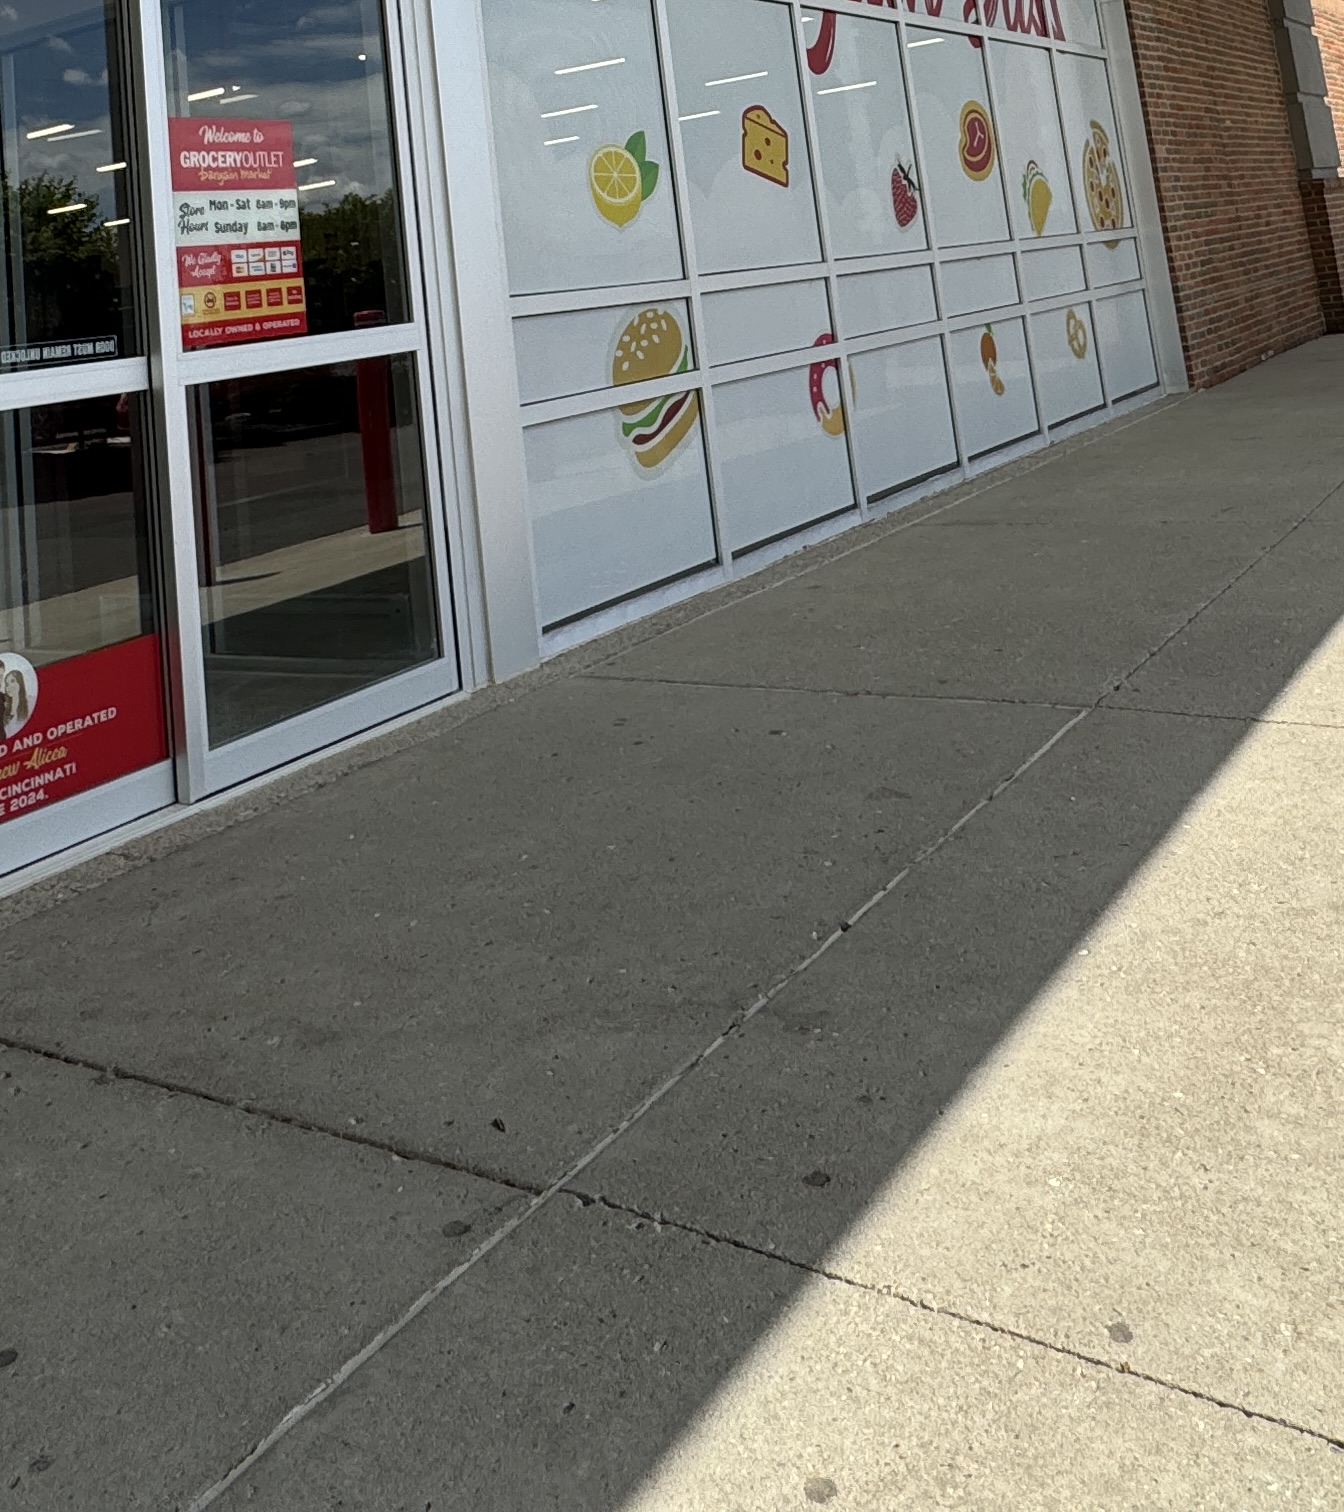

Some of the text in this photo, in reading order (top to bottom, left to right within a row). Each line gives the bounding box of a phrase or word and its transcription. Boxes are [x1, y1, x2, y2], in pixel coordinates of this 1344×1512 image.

[199, 124, 264, 145] Welcome to
[198, 168, 238, 186] bargain
[208, 199, 229, 211] Mon
[235, 198, 251, 211] Sat
[214, 221, 249, 235] Sunday
[188, 327, 223, 339] LOCALLY
[225, 323, 254, 335] OWNED
[262, 318, 301, 330] OPERATED
[12, 732, 43, 753] AND
[46, 706, 118, 740] OPERATED
[23, 745, 68, 770] Alicea
[10, 788, 50, 812] 2024.
